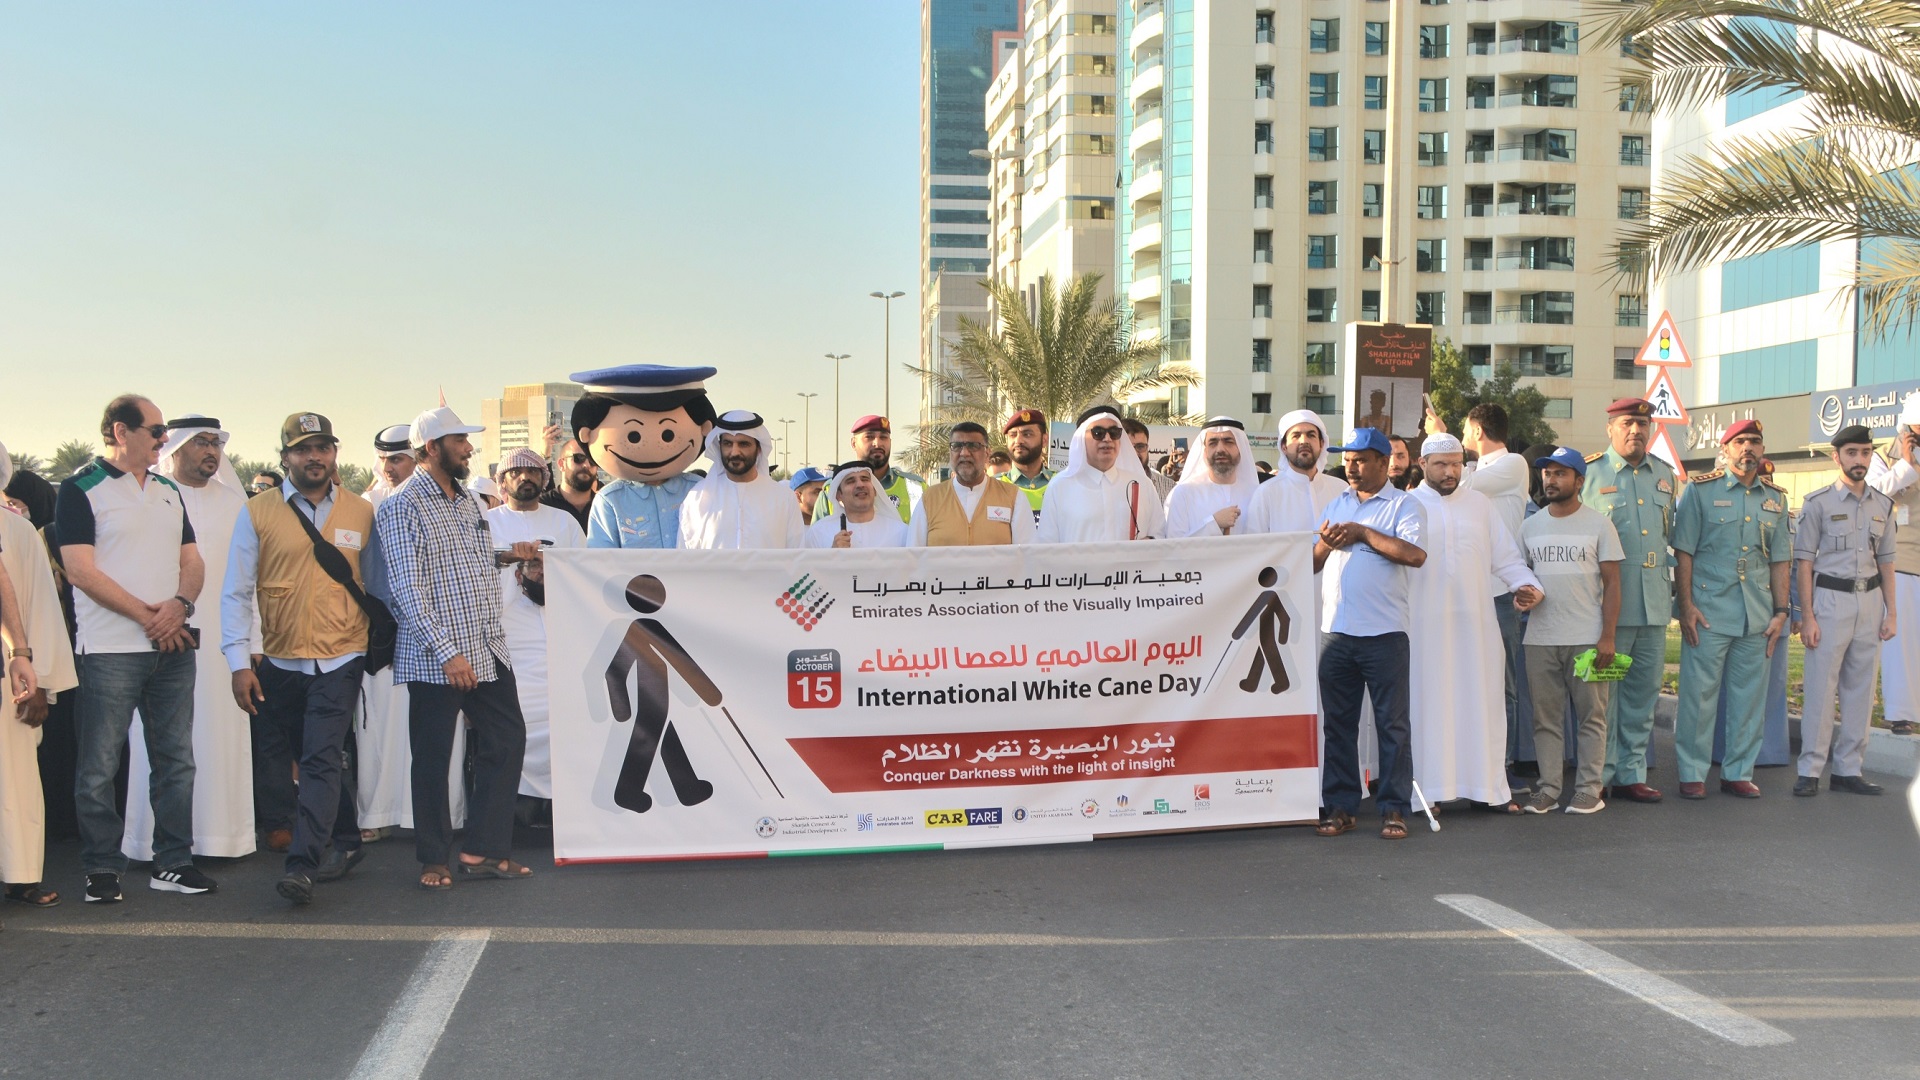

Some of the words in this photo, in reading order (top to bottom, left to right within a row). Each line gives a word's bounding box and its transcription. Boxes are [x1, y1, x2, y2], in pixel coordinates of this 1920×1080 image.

[1368, 351, 1401, 359] SHARJAH
[1403, 352, 1420, 360] FILM
[1375, 358, 1413, 366] PLATFORM
[1846, 391, 1897, 411] للصرافة
[1860, 414, 1896, 429] ANSARI
[1530, 546, 1587, 563] AMERICA
[931, 573, 1051, 595] للمعاقين
[1055, 571, 1129, 590] الإمارات
[1133, 570, 1202, 586] جمعية
[852, 605, 923, 618] Emirates
[927, 602, 1019, 616] Association
[1024, 600, 1040, 614] of
[1044, 600, 1069, 612] the
[1072, 597, 1132, 611] Visually
[1136, 593, 1204, 609] Impaired
[795, 651, 833, 664] أكتوبر
[953, 644, 1028, 669] للعصا
[1035, 639, 1137, 673] العالمي
[1143, 635, 1202, 666] اليوم
[795, 663, 834, 671] OCTOBER
[857, 647, 948, 678] البيضاء
[796, 676, 834, 703] 15
[857, 681, 1017, 707] International
[1022, 679, 1092, 700] White
[1097, 677, 1153, 697] Cane
[1158, 673, 1203, 697] Day
[965, 739, 1022, 764] نقهر
[1028, 734, 1119, 761] البصيرة
[1123, 732, 1176, 754] بنور
[881, 742, 961, 768] الظلام
[883, 771, 946, 784] Conquer
[949, 767, 1016, 780] Darkness
[1020, 765, 1049, 777] with
[1053, 764, 1074, 775] the
[1077, 761, 1108, 775] light
[1111, 759, 1126, 771] of
[1129, 757, 1176, 772] insight
[1235, 778, 1273, 787] برعاية
[927, 813, 963, 825] CAR
[970, 811, 998, 823] FARE
